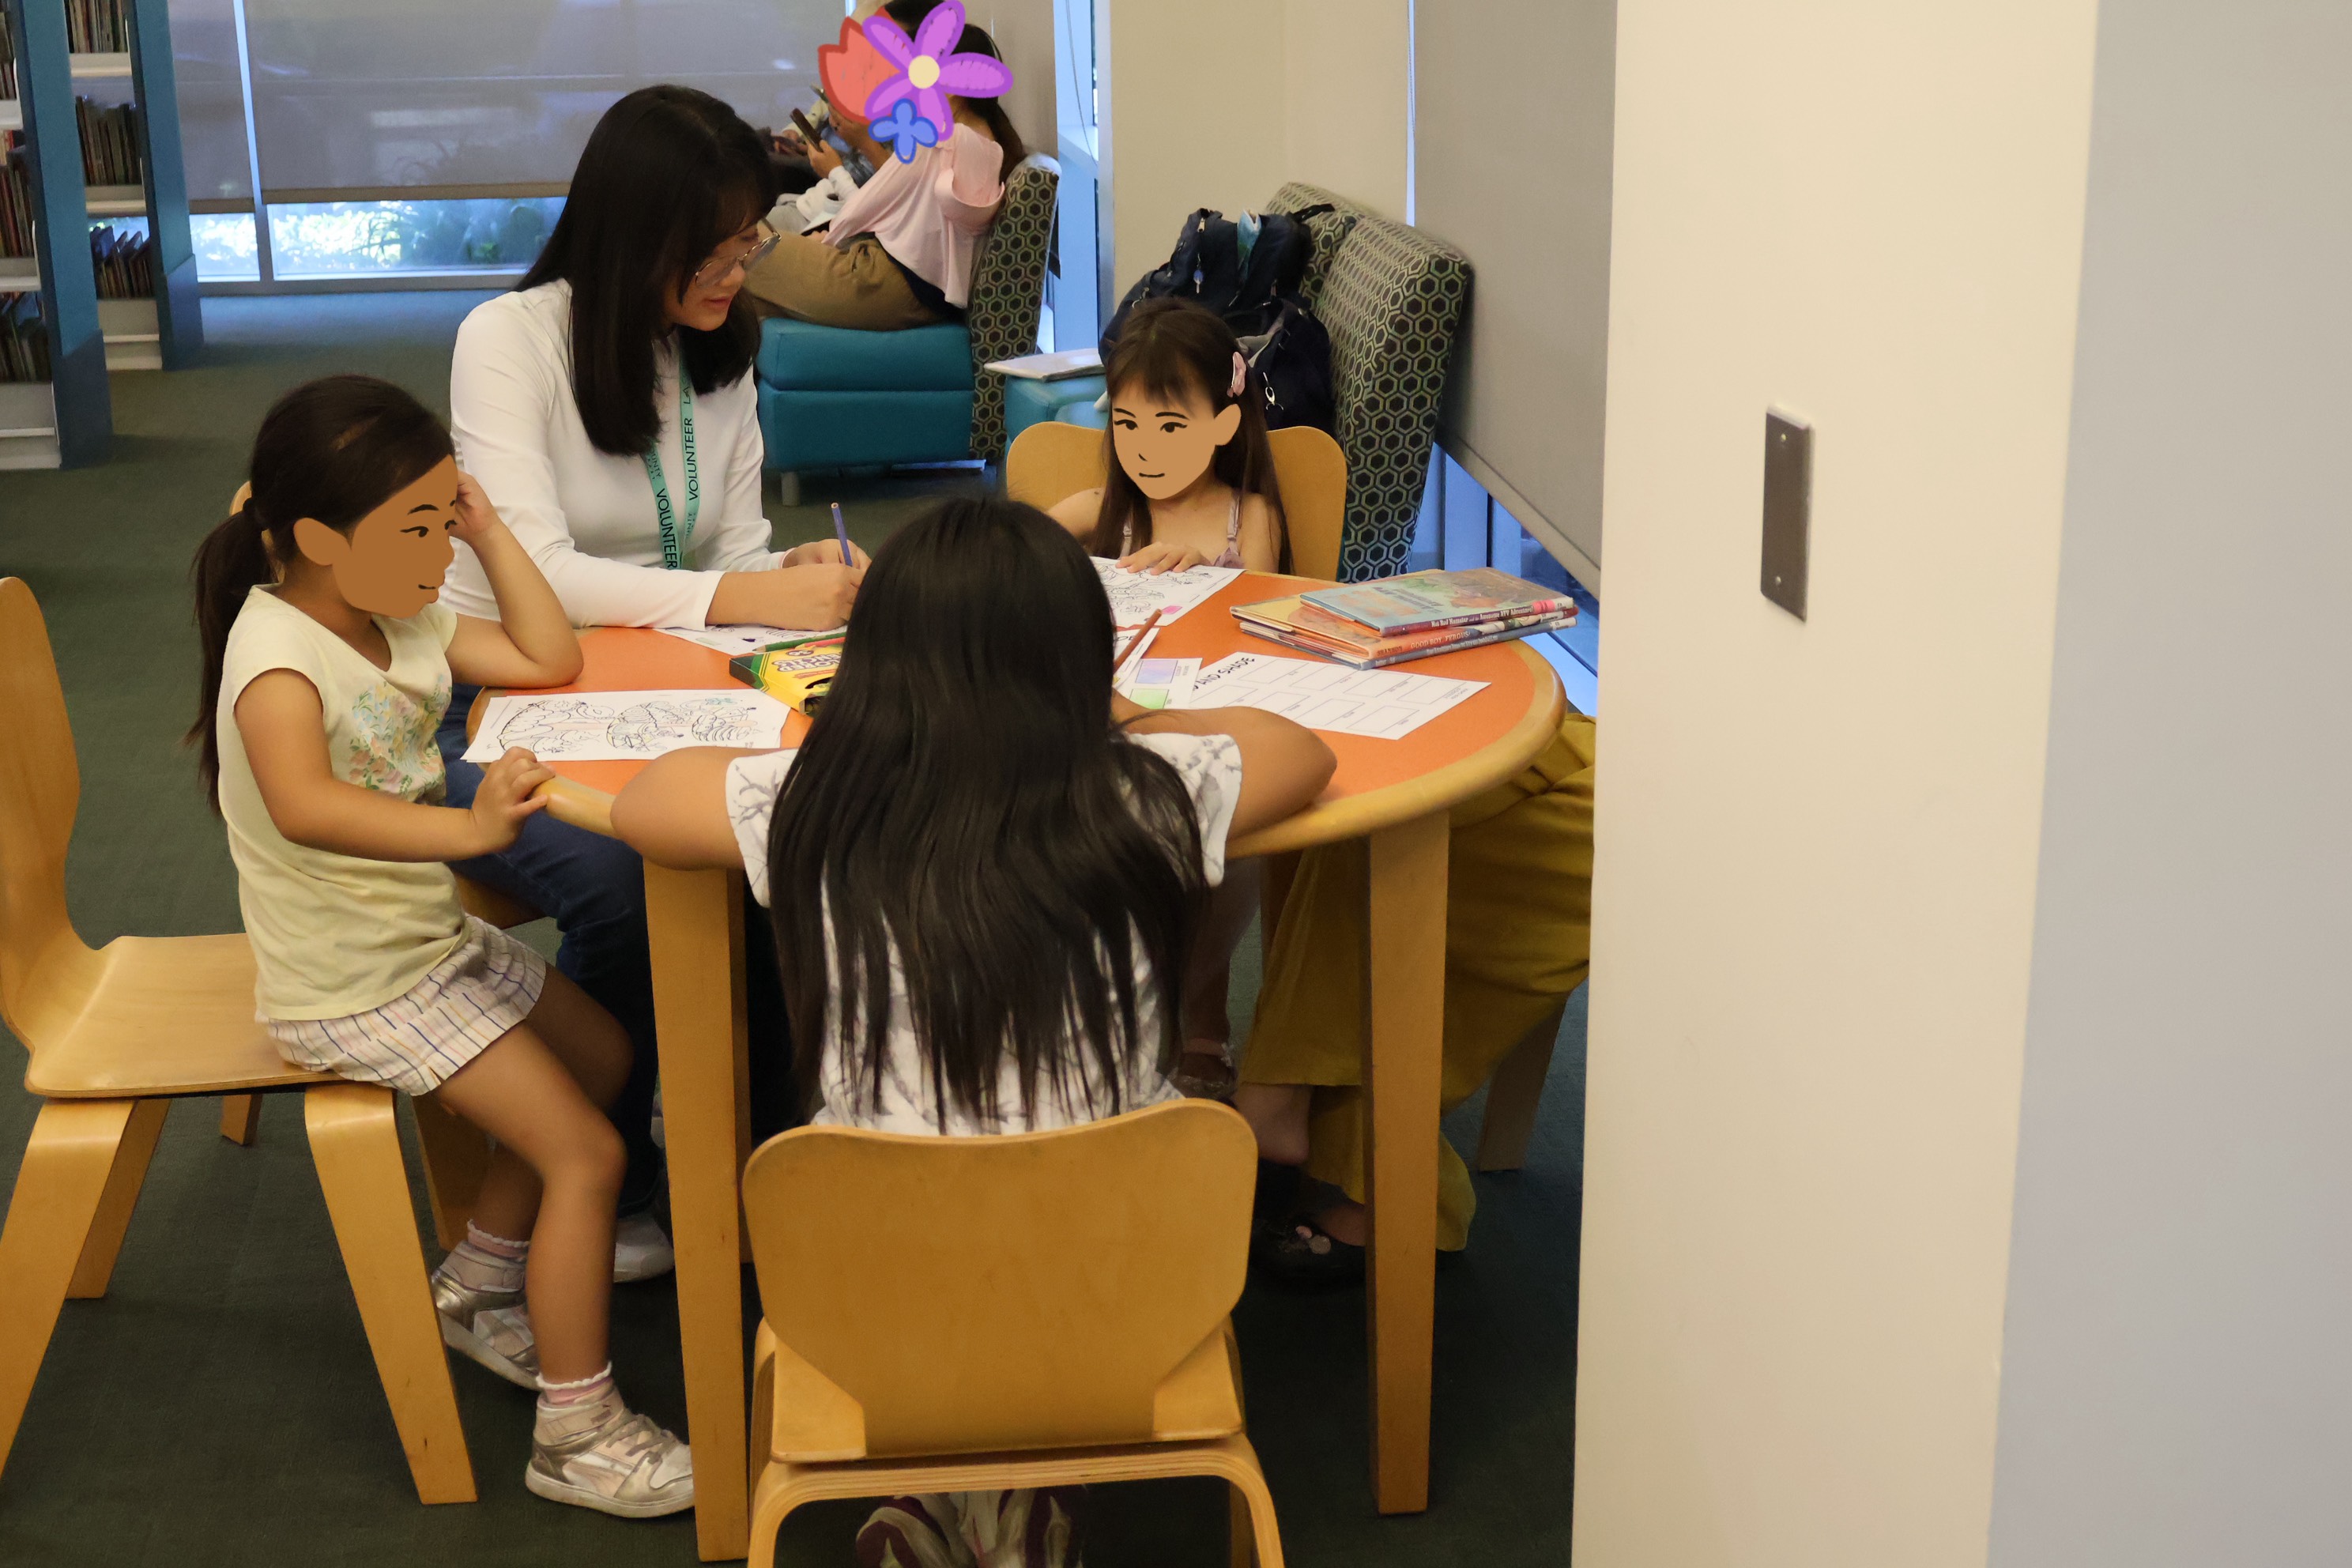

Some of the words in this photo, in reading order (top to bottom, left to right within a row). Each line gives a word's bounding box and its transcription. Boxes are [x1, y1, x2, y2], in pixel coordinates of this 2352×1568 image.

[684, 417, 699, 501] VOLUNTEER
[656, 488, 678, 569] VOLUNTEER
[771, 653, 842, 667] ENCILS
[778, 659, 841, 673] LORED
[1195, 673, 1221, 685] AND
[1217, 658, 1255, 675] SHADE
